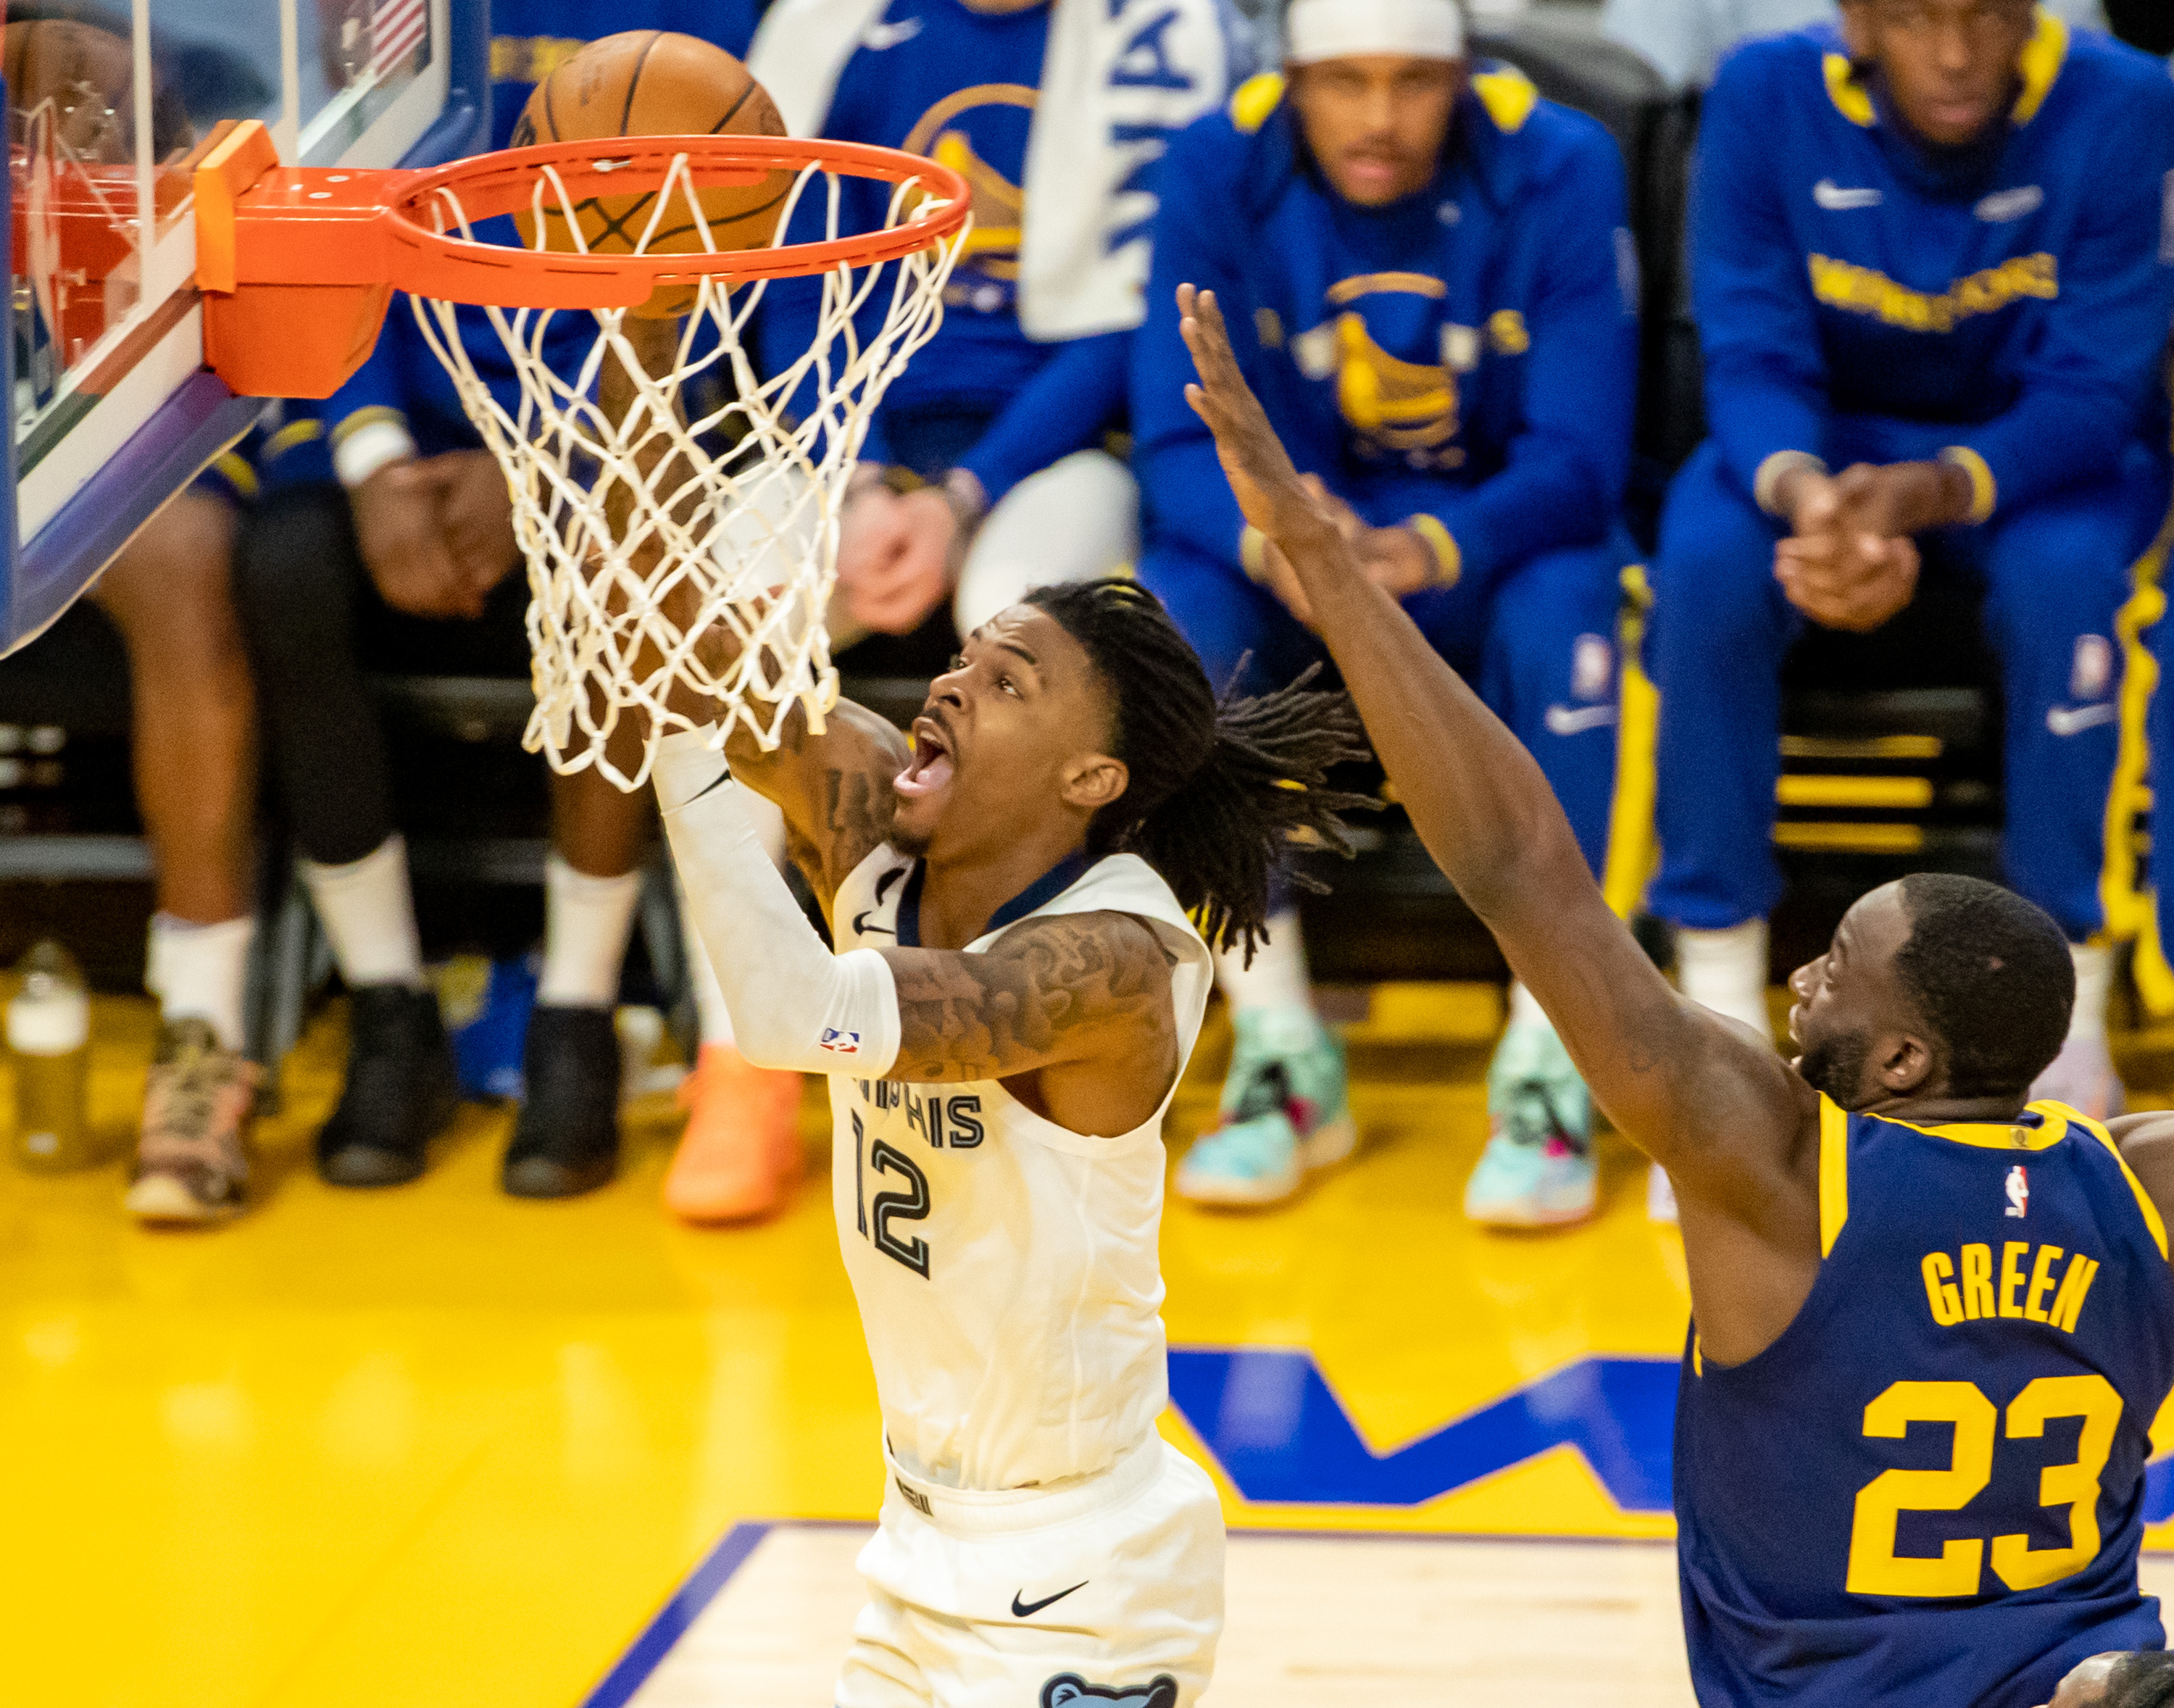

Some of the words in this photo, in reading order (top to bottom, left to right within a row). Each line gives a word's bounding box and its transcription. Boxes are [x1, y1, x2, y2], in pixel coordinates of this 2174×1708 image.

[851, 1107, 930, 1281] 12
[1921, 1241, 2100, 1333] GREEN
[1846, 1374, 2123, 1597] 23
